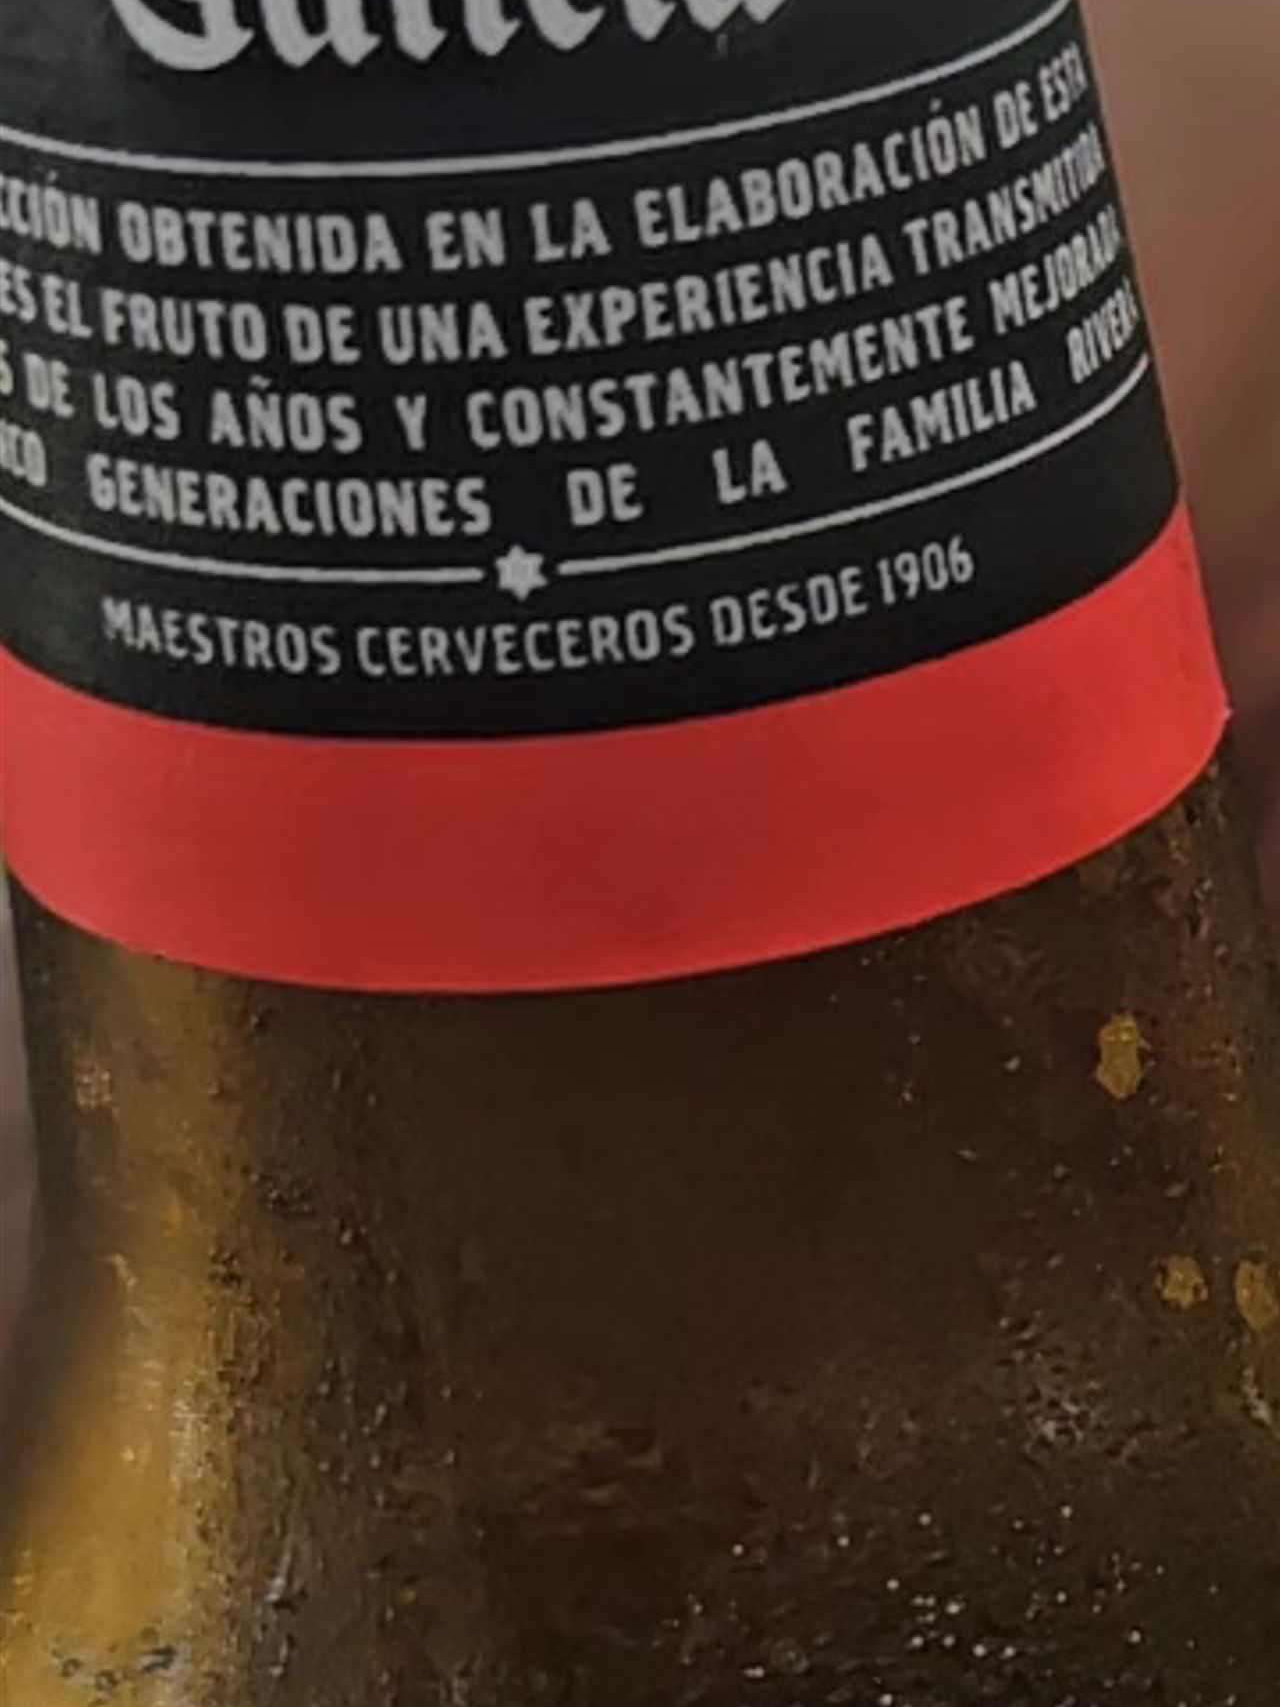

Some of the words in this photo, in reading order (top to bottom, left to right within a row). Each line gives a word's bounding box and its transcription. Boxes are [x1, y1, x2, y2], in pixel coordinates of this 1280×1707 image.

[0, 170, 101, 254] CIÓN
[117, 202, 402, 273] OBTENIDA
[426, 209, 505, 270] EN
[530, 198, 611, 261] LA
[634, 98, 986, 249] ELABORACIÓN
[994, 81, 1038, 149] DE
[23, 352, 74, 418] DE
[92, 373, 180, 440] LOS
[210, 375, 362, 451] AÑOS
[397, 393, 427, 450] Y
[467, 295, 975, 449] CONSTANTEMENTE
[42, 273, 92, 338] EL
[101, 286, 268, 360] FRUTO
[284, 303, 360, 364] DE
[379, 302, 507, 364] UNA
[525, 234, 894, 355] EXPERIENCIA
[87, 453, 492, 535] GENERACIONES
[567, 463, 642, 526] DE
[714, 439, 787, 505] LA
[847, 360, 1037, 471] FAMILIA
[103, 596, 341, 675] MAESTROS
[357, 605, 695, 677] CERVECEROS
[711, 566, 869, 645] DESDE
[877, 535, 974, 605] 1906
